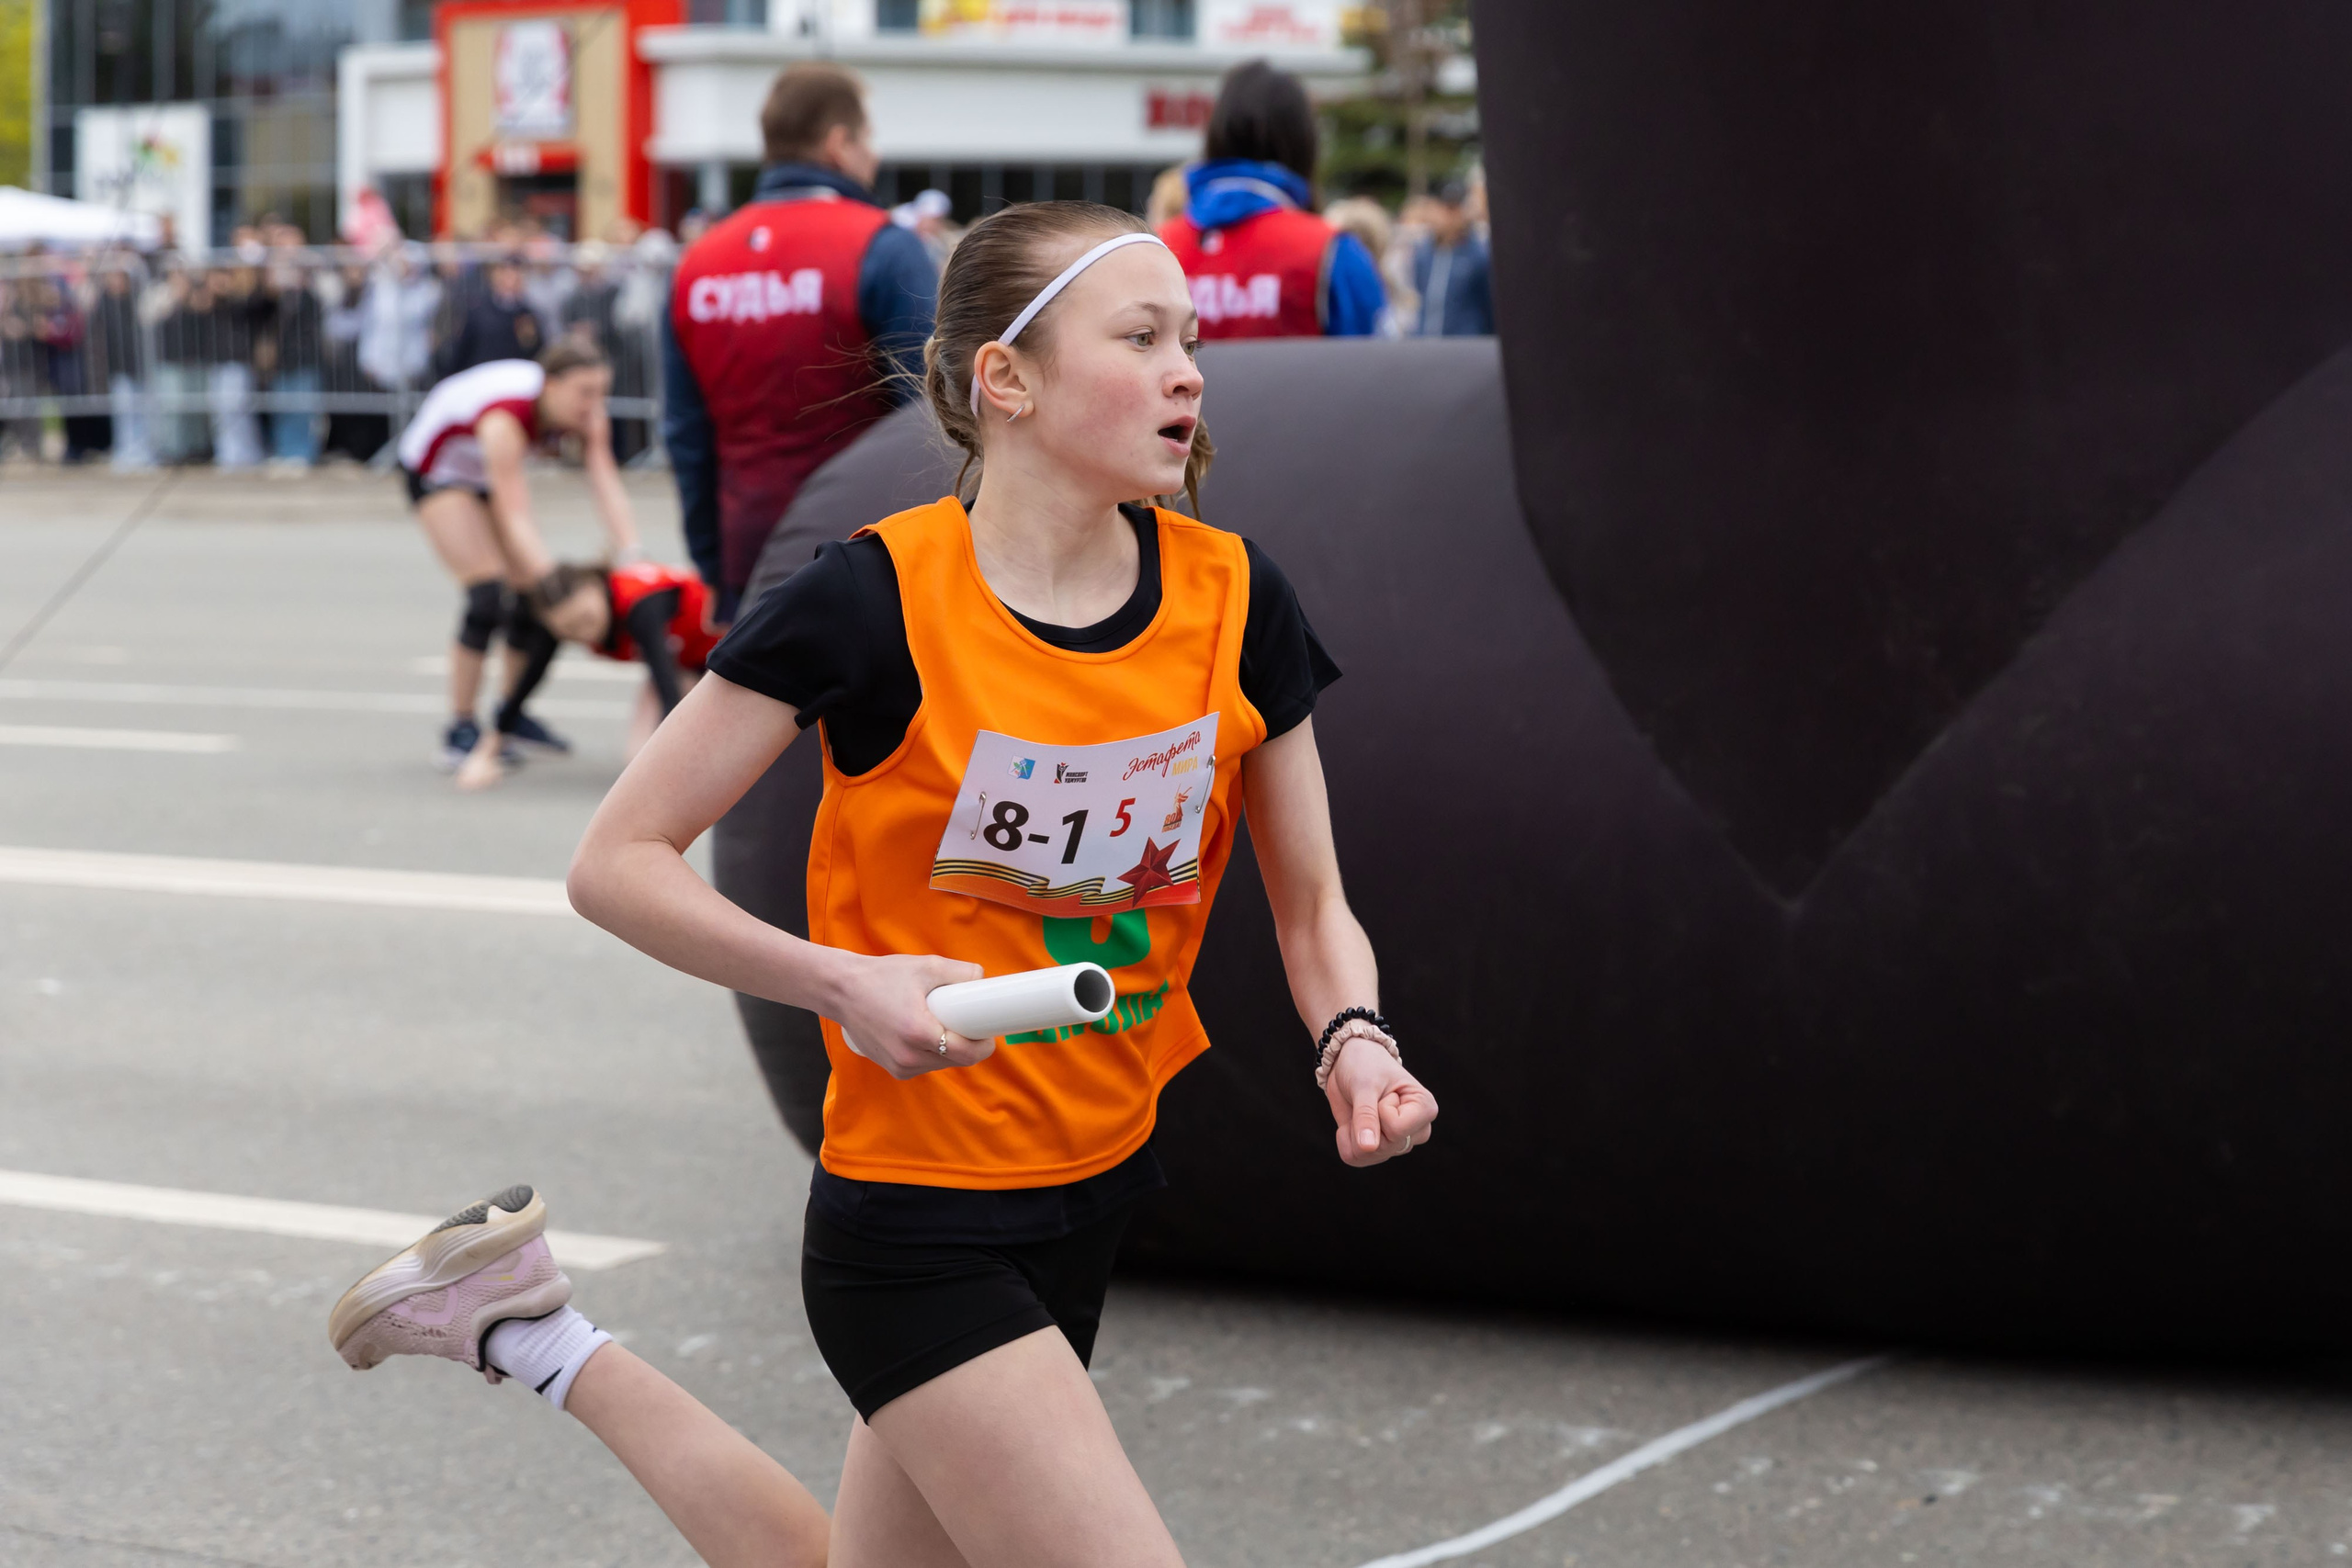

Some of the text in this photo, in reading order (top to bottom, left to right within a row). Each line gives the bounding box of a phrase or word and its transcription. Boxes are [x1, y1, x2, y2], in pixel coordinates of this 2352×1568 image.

[688, 268, 823, 325] СУДЬЯ
[1187, 273, 1280, 325] ДЬЯ
[1122, 730, 1201, 781] Эстафета
[1171, 755, 1198, 776] МИРА
[983, 797, 1136, 864] 8-1 5
